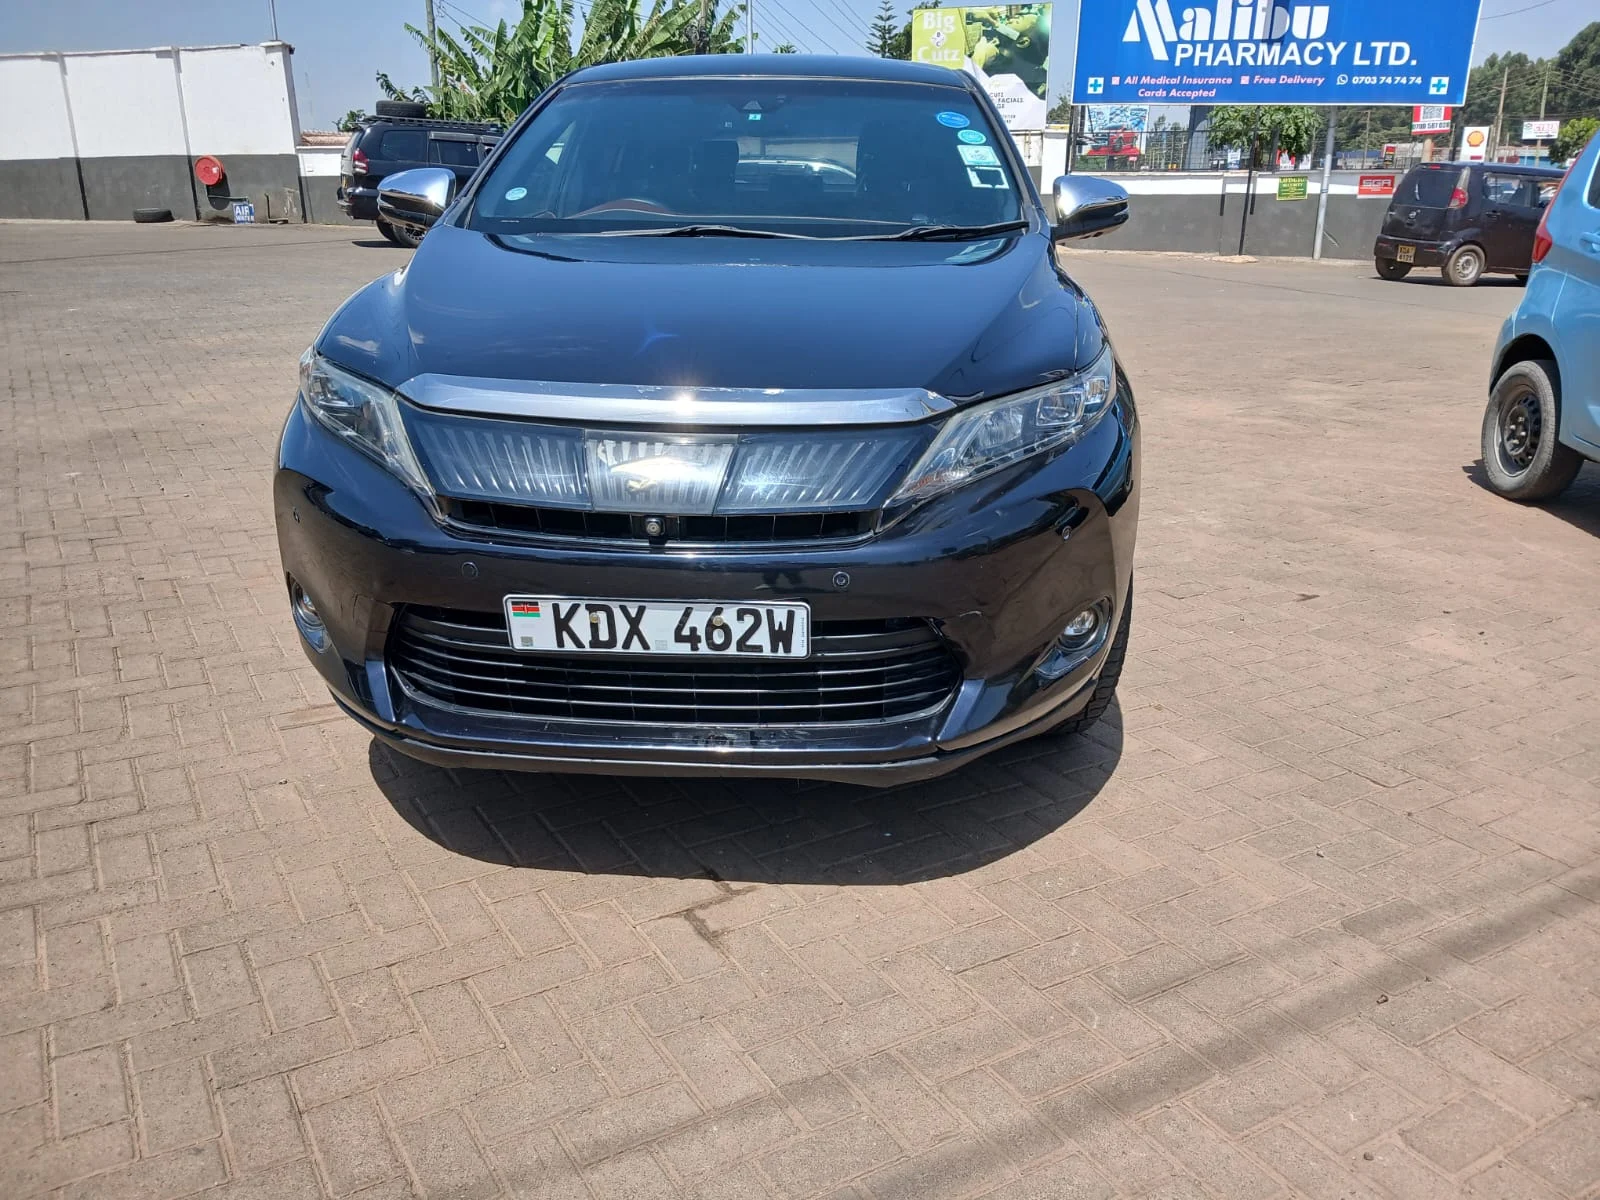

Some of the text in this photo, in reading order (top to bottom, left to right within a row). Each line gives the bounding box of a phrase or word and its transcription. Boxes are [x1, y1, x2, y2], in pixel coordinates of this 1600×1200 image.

[923, 11, 955, 33] Big
[1122, 0, 1330, 61] Malibu
[917, 46, 961, 62] Cutz
[1174, 42, 1417, 66] PHARMACY LTD.
[1124, 76, 1233, 85] All Medical Insurance
[1253, 76, 1325, 86] Free Delivery
[1138, 88, 1216, 99] Cards Accepted
[236, 204, 249, 215] AIR
[551, 602, 651, 651] KDX
[673, 606, 796, 654] 462W
